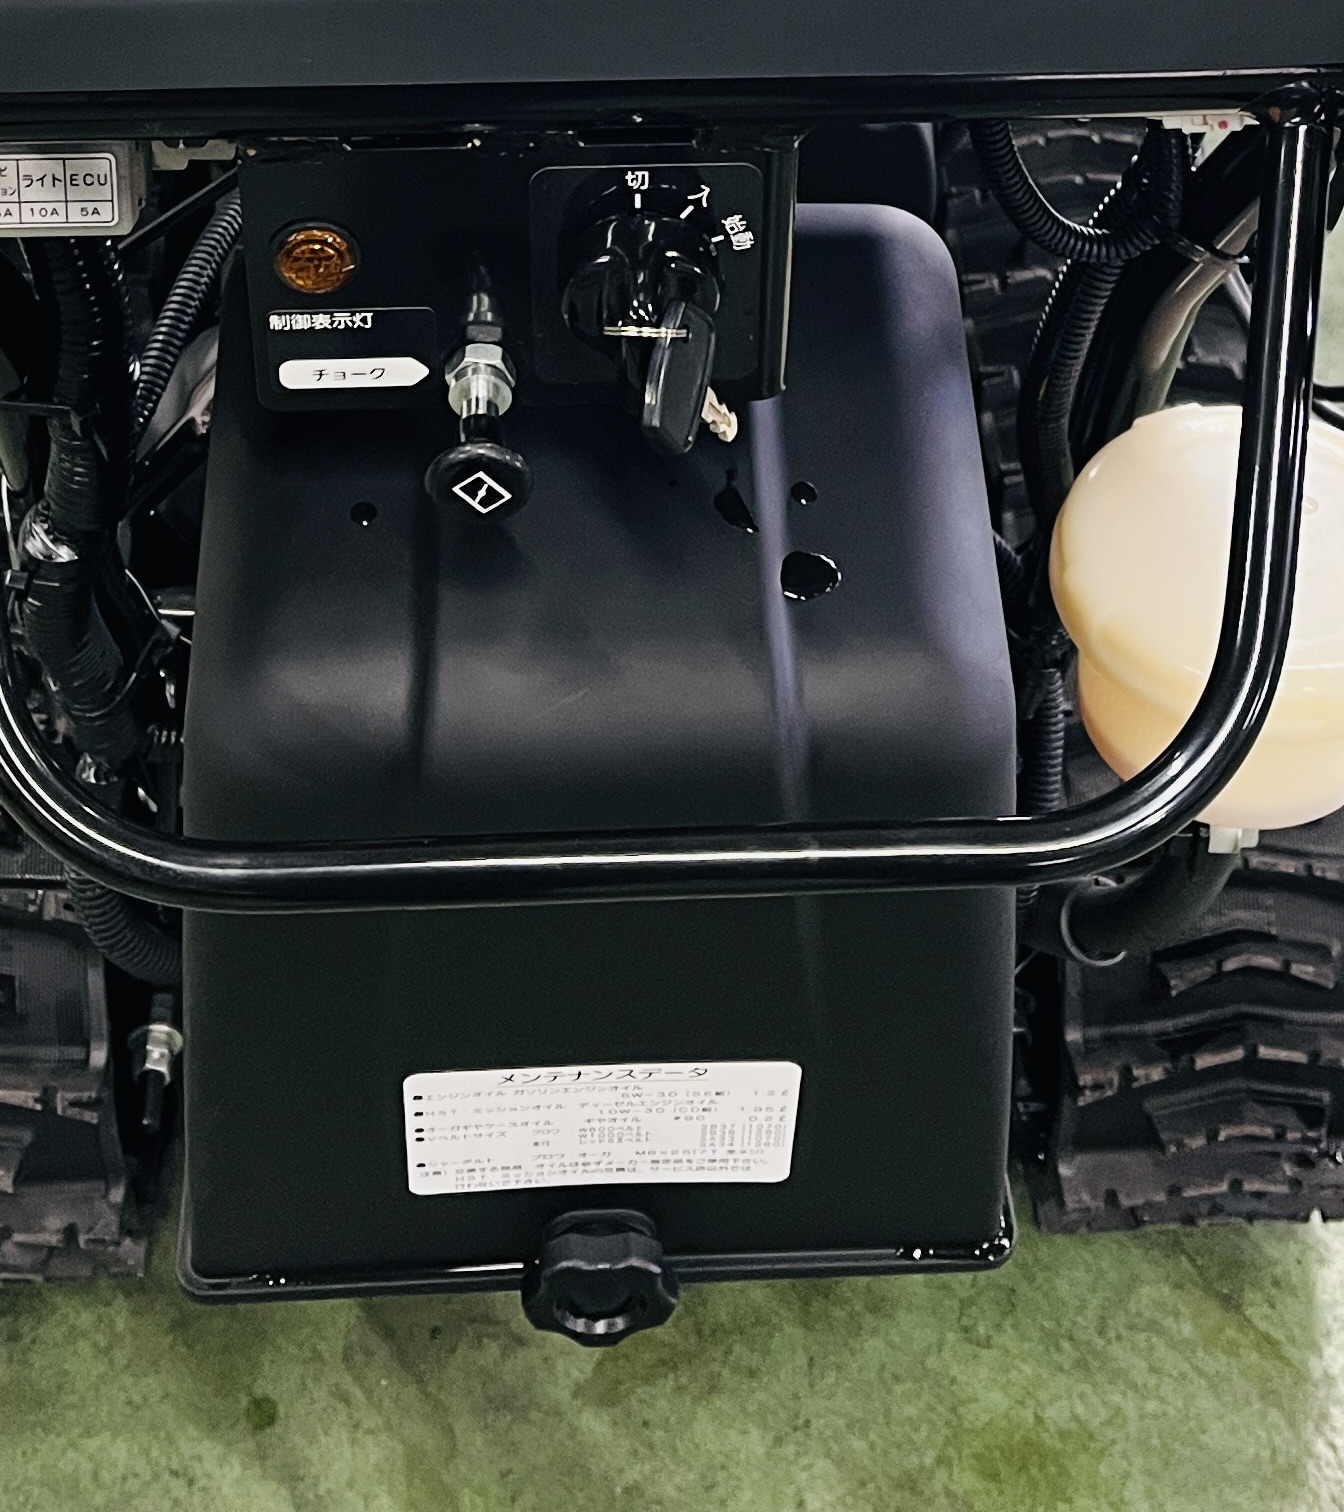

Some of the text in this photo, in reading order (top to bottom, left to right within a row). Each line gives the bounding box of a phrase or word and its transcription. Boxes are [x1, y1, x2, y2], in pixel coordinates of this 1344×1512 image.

[22, 173, 63, 188] ライト
[69, 172, 108, 187] ECU
[624, 170, 650, 190] 切
[687, 184, 711, 208] 入
[29, 207, 60, 218] 10A
[80, 206, 102, 217] 5A
[269, 311, 374, 330] 制御表示灯
[311, 366, 387, 382] チョーク
[497, 1066, 709, 1086] メンテナンスデータ
